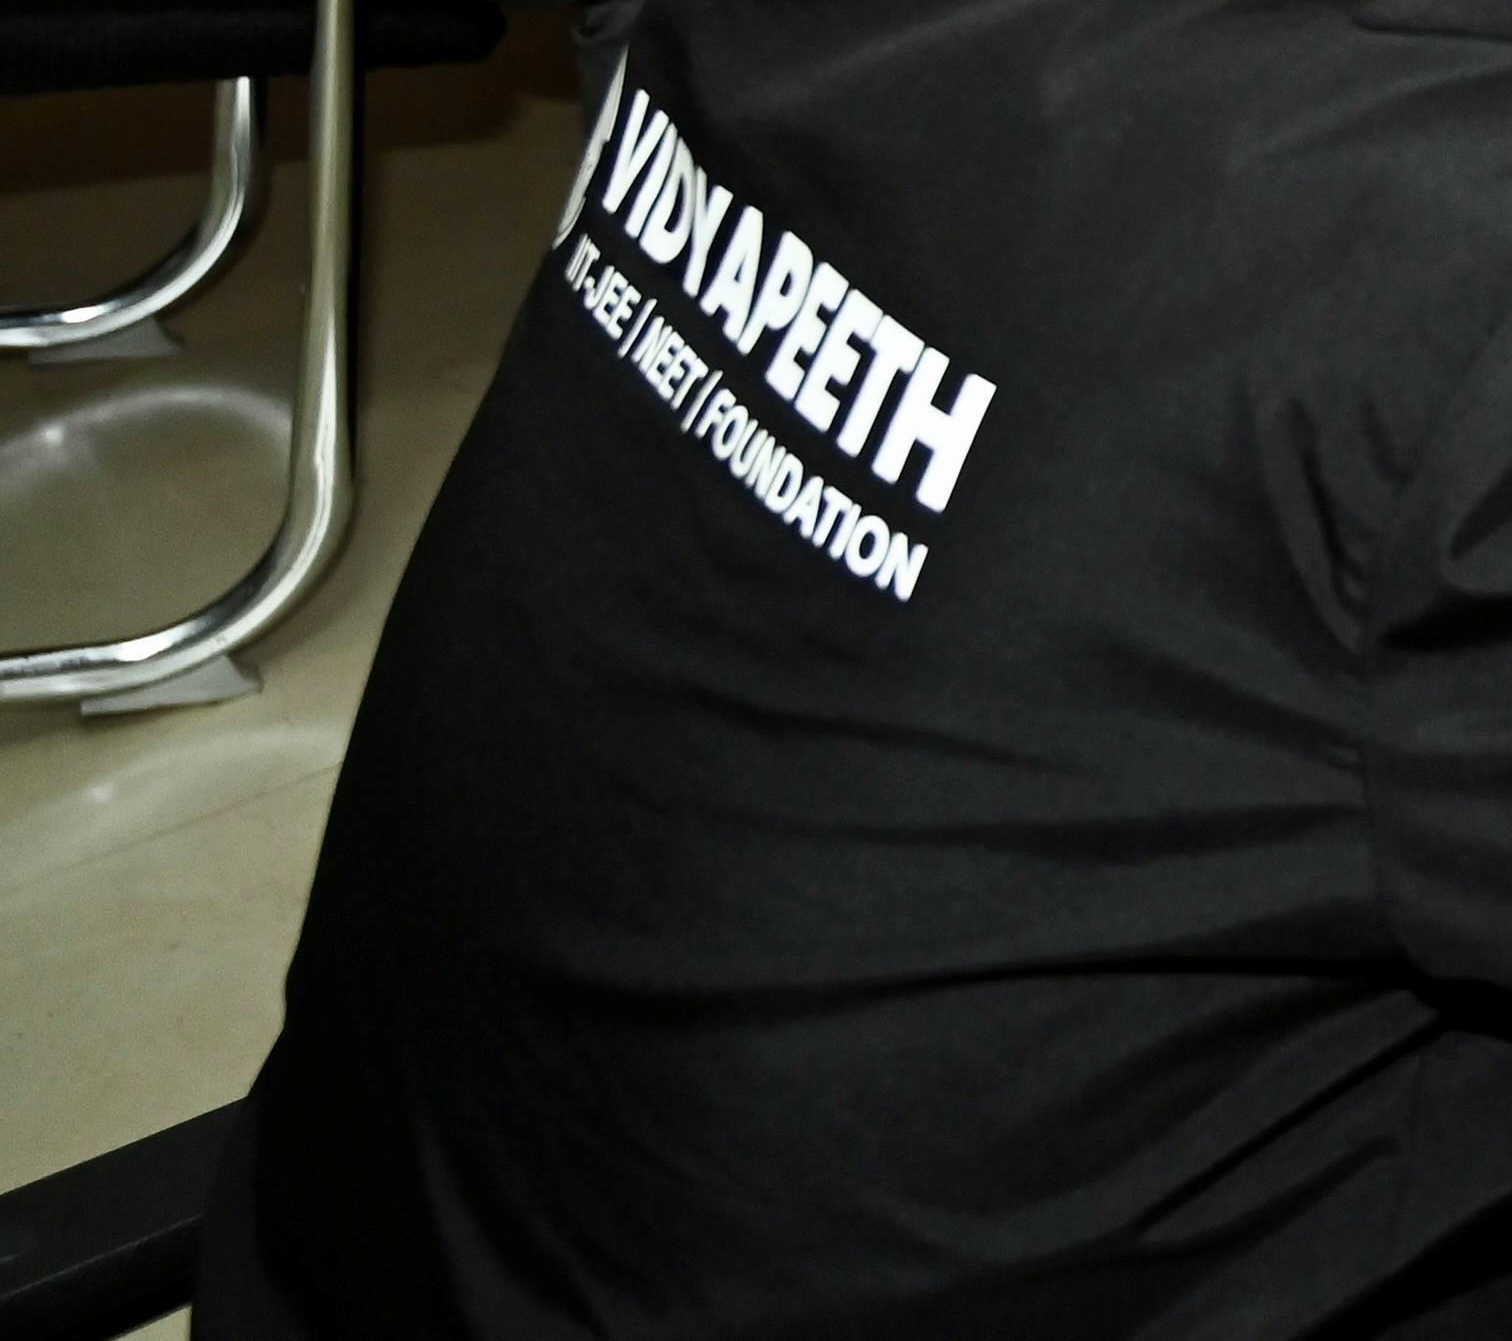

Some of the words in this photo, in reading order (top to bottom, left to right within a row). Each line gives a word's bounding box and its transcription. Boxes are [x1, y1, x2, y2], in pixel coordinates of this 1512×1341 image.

[602, 88, 998, 513] VIDYAPEETH
[631, 315, 710, 412] NEET
[694, 387, 928, 601] FOUNDATION
